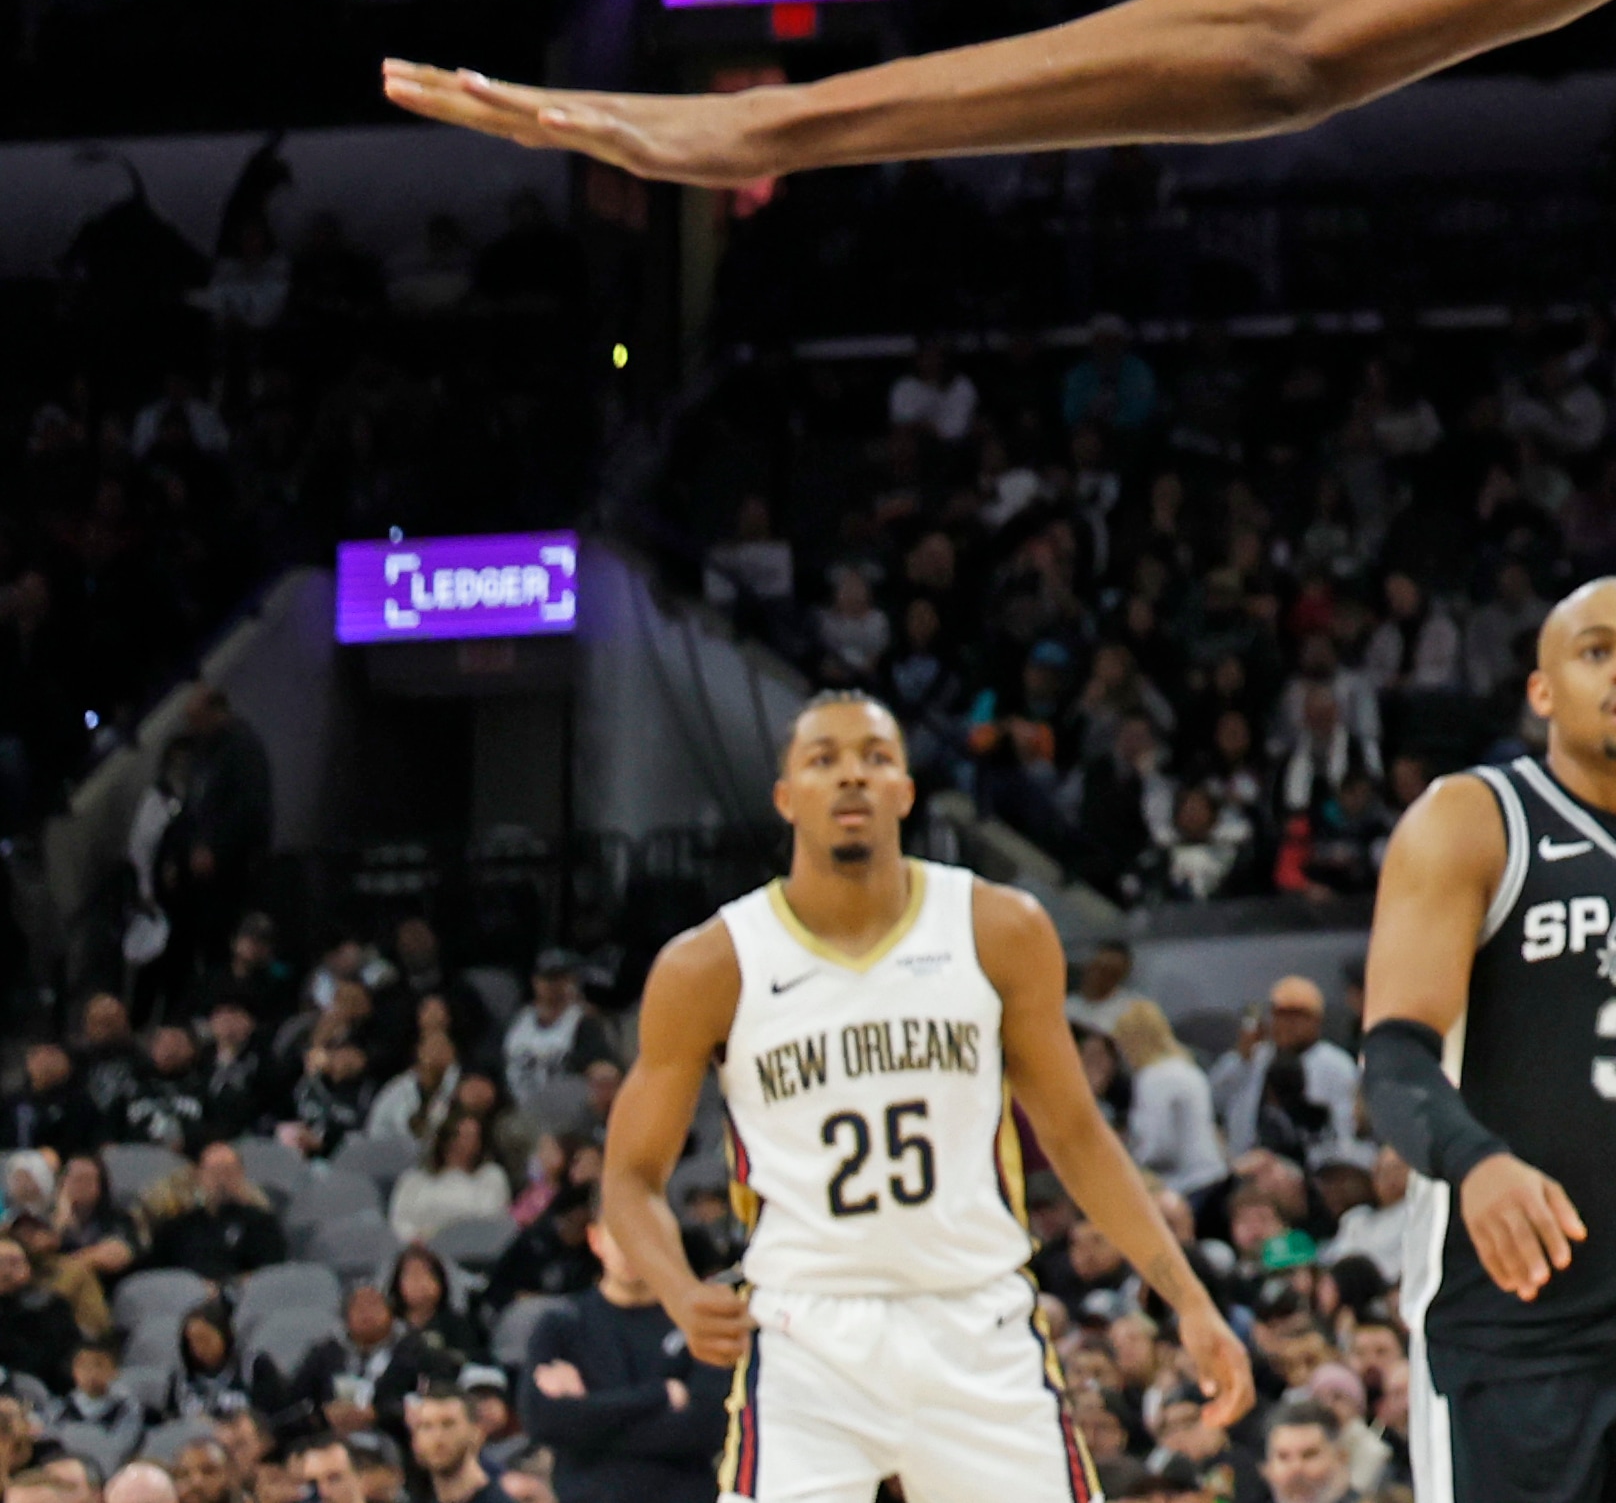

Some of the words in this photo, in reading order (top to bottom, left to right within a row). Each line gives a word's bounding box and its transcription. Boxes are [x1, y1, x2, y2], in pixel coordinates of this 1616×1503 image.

[411, 564, 549, 611] LEDGER
[755, 1031, 827, 1106] NEW
[841, 1017, 980, 1080] ORLEANS
[821, 1099, 936, 1218] 25
